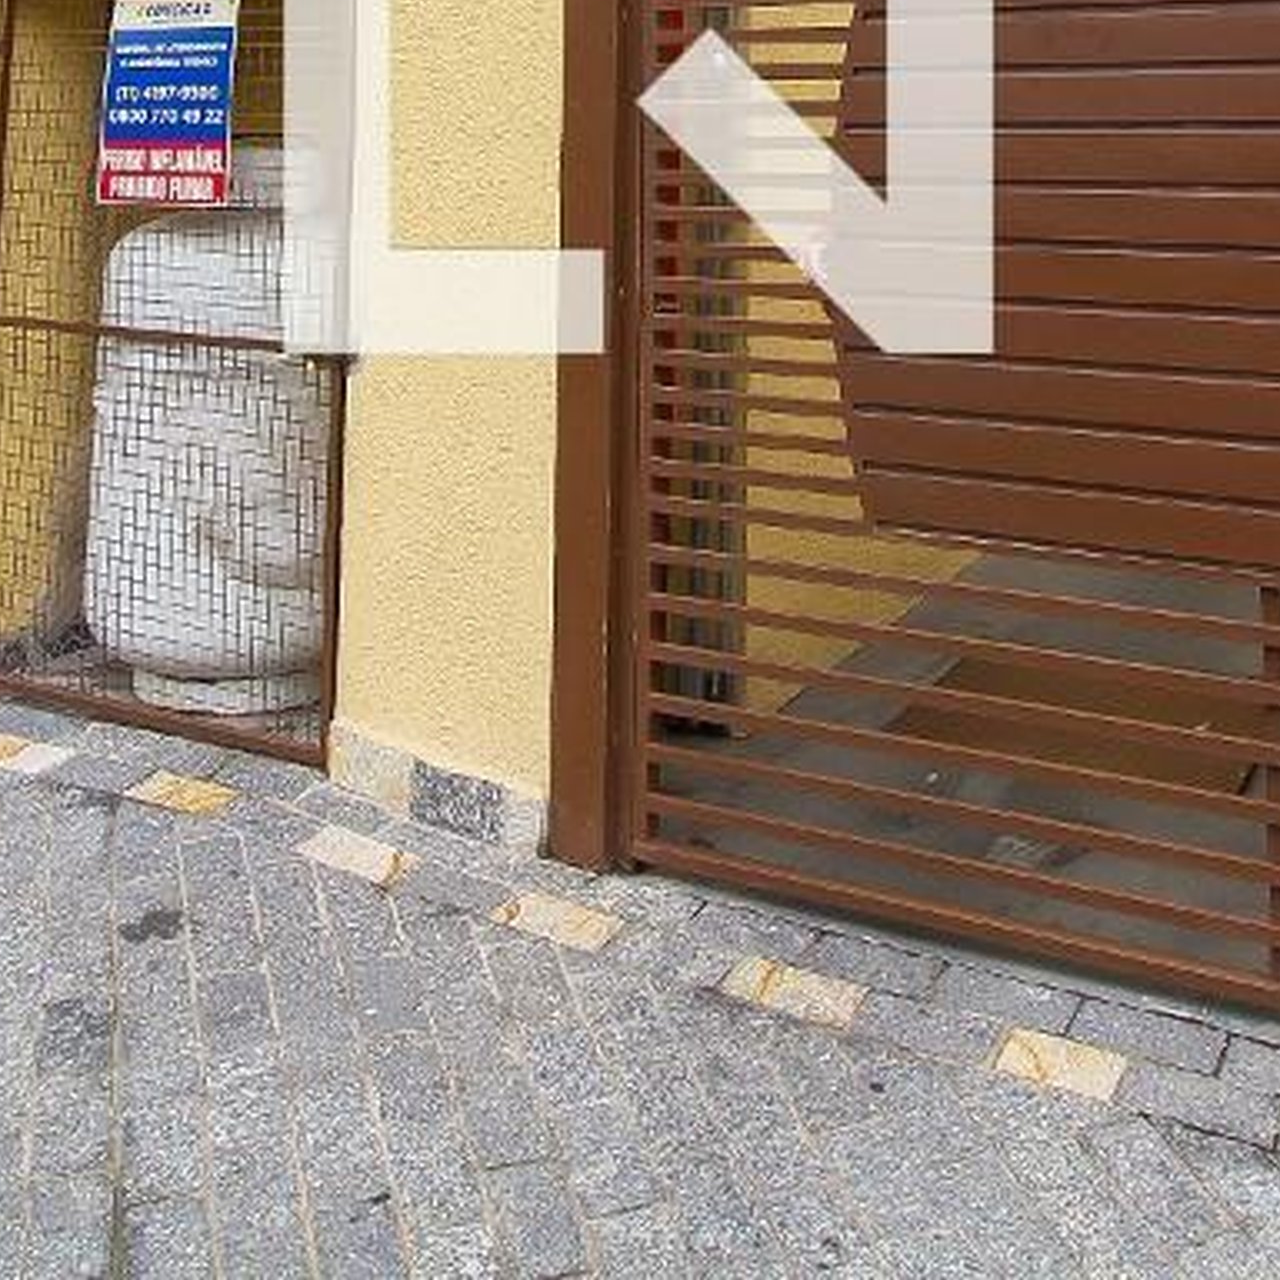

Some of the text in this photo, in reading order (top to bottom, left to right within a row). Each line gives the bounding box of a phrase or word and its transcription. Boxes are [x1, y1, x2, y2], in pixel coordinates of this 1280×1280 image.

[109, 109, 148, 125] 0800
[203, 108, 223, 124] 22
[109, 176, 214, 200] PROIBIDO FUMAR
